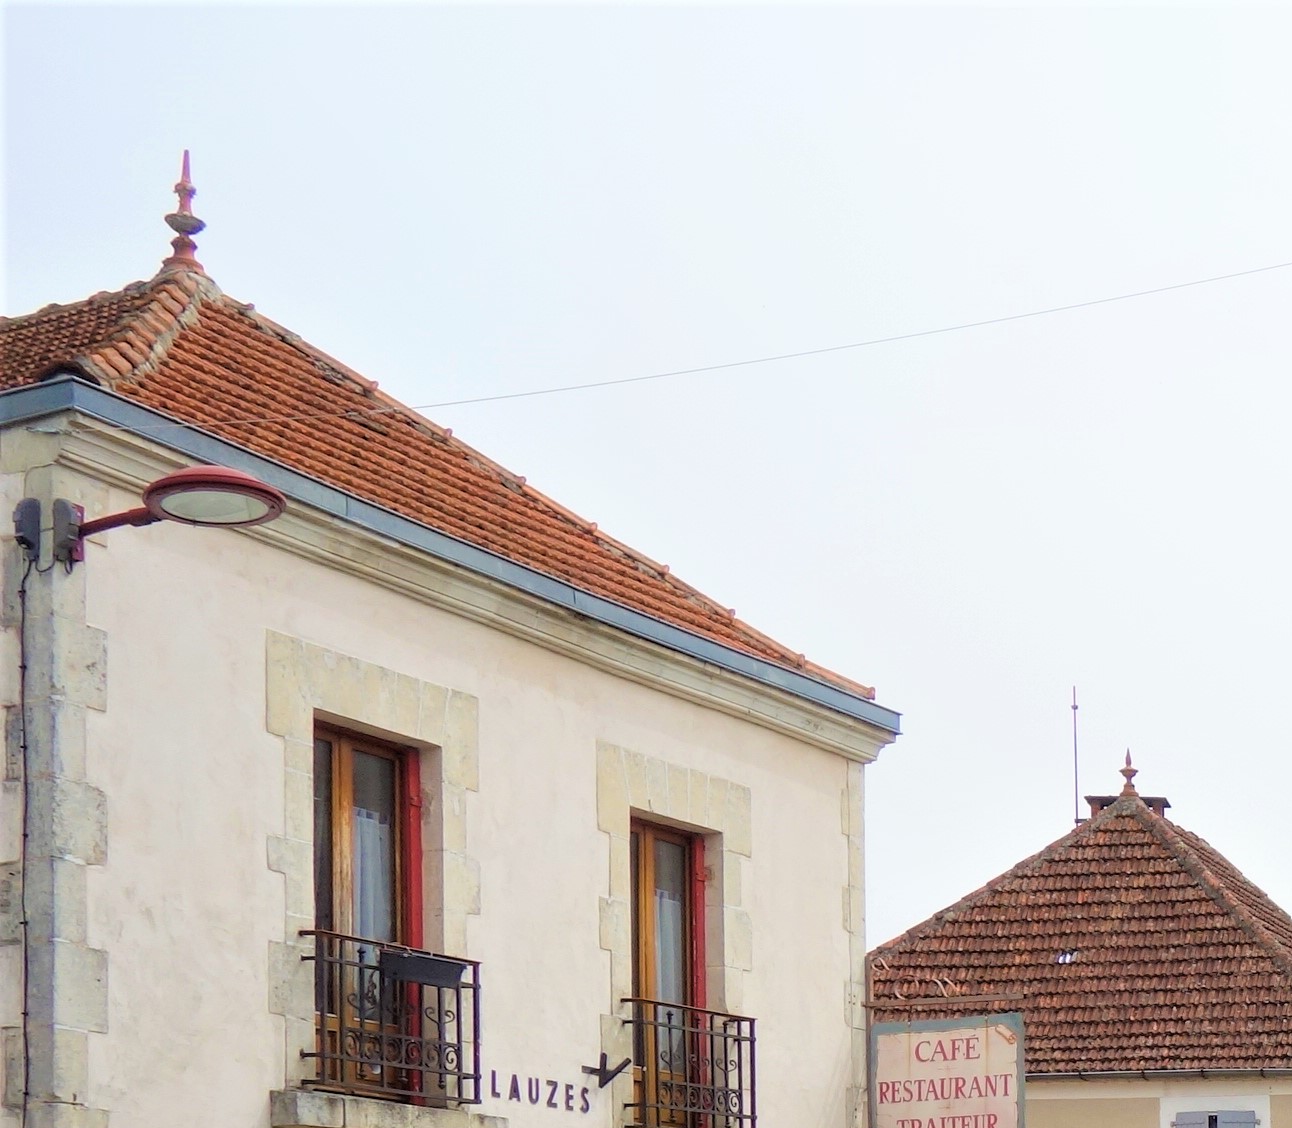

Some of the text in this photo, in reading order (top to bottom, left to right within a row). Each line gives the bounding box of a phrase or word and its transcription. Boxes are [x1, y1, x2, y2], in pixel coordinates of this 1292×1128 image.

[914, 1034, 981, 1062] CAFÉ
[491, 1069, 590, 1113] LAUZES
[878, 1073, 1013, 1104] RESTAURANT
